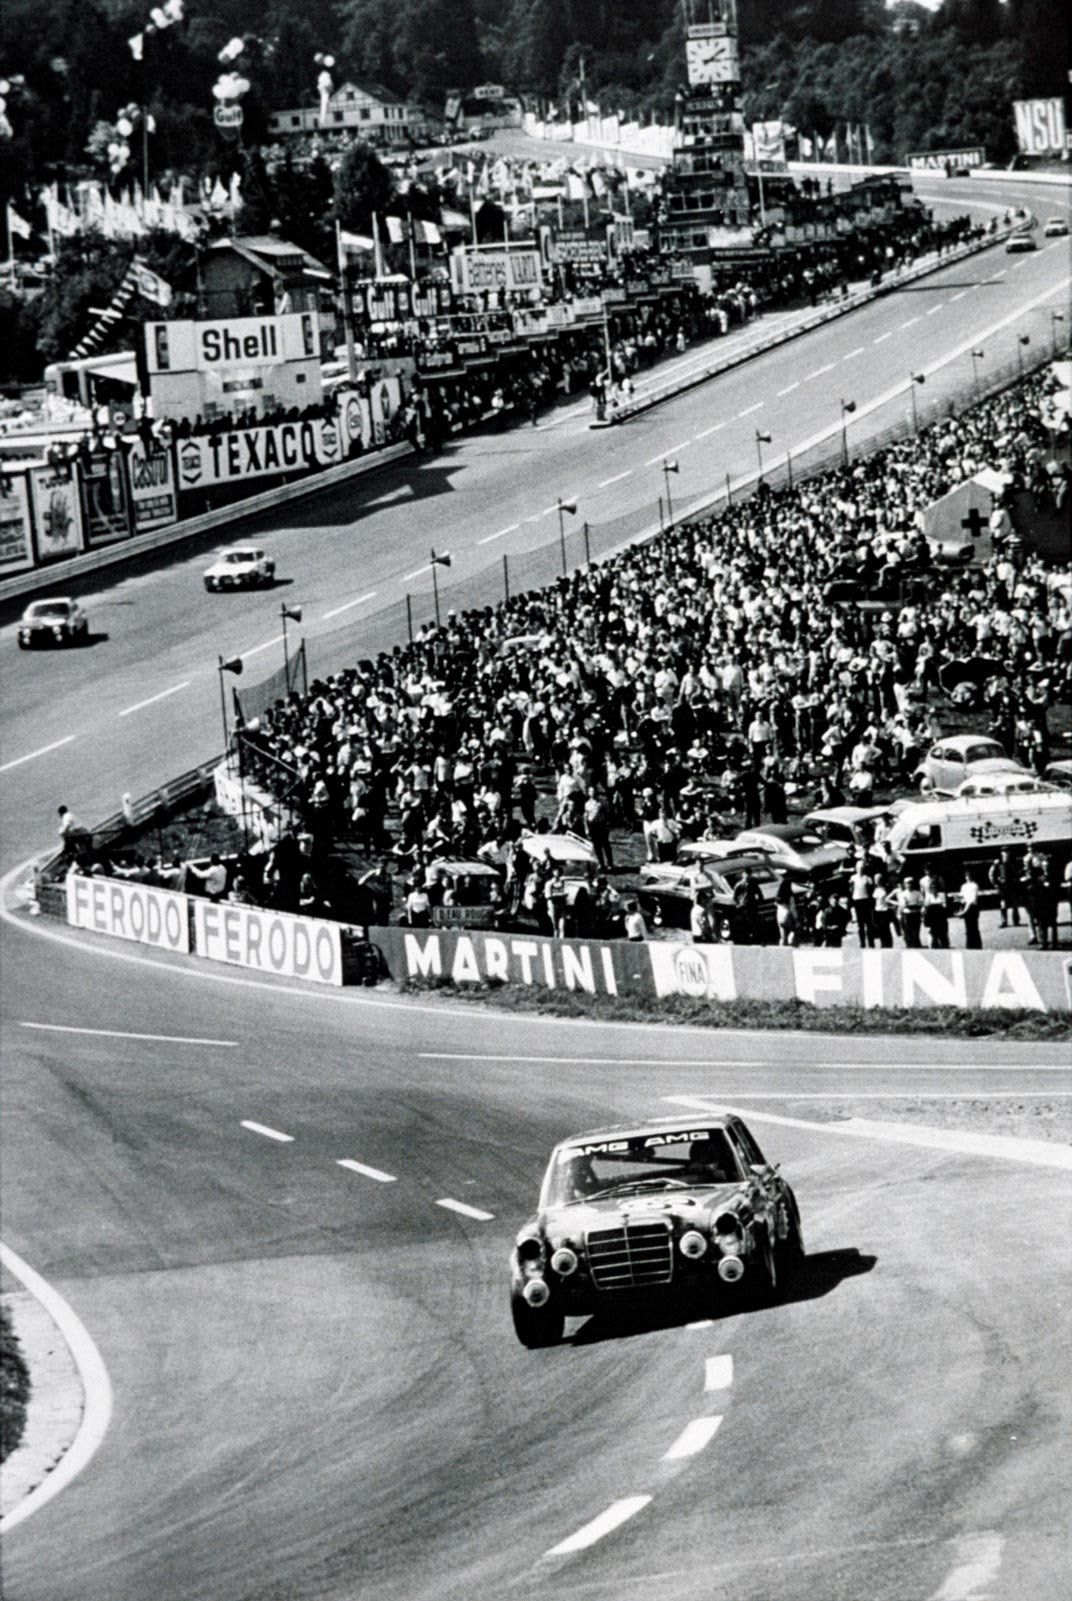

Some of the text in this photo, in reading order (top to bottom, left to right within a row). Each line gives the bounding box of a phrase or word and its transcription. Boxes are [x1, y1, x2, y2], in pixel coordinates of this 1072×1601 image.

[1014, 99, 1065, 154] NSU
[911, 152, 980, 169] MARTINI
[202, 325, 277, 361] Shell
[208, 422, 314, 478] TEXACO
[75, 881, 181, 947] FERODO
[203, 906, 335, 980] FERODO
[404, 934, 618, 996] MARTINI
[680, 961, 706, 984] FINA
[793, 950, 1049, 1013] FINA
[644, 1132, 710, 1147] AMG
